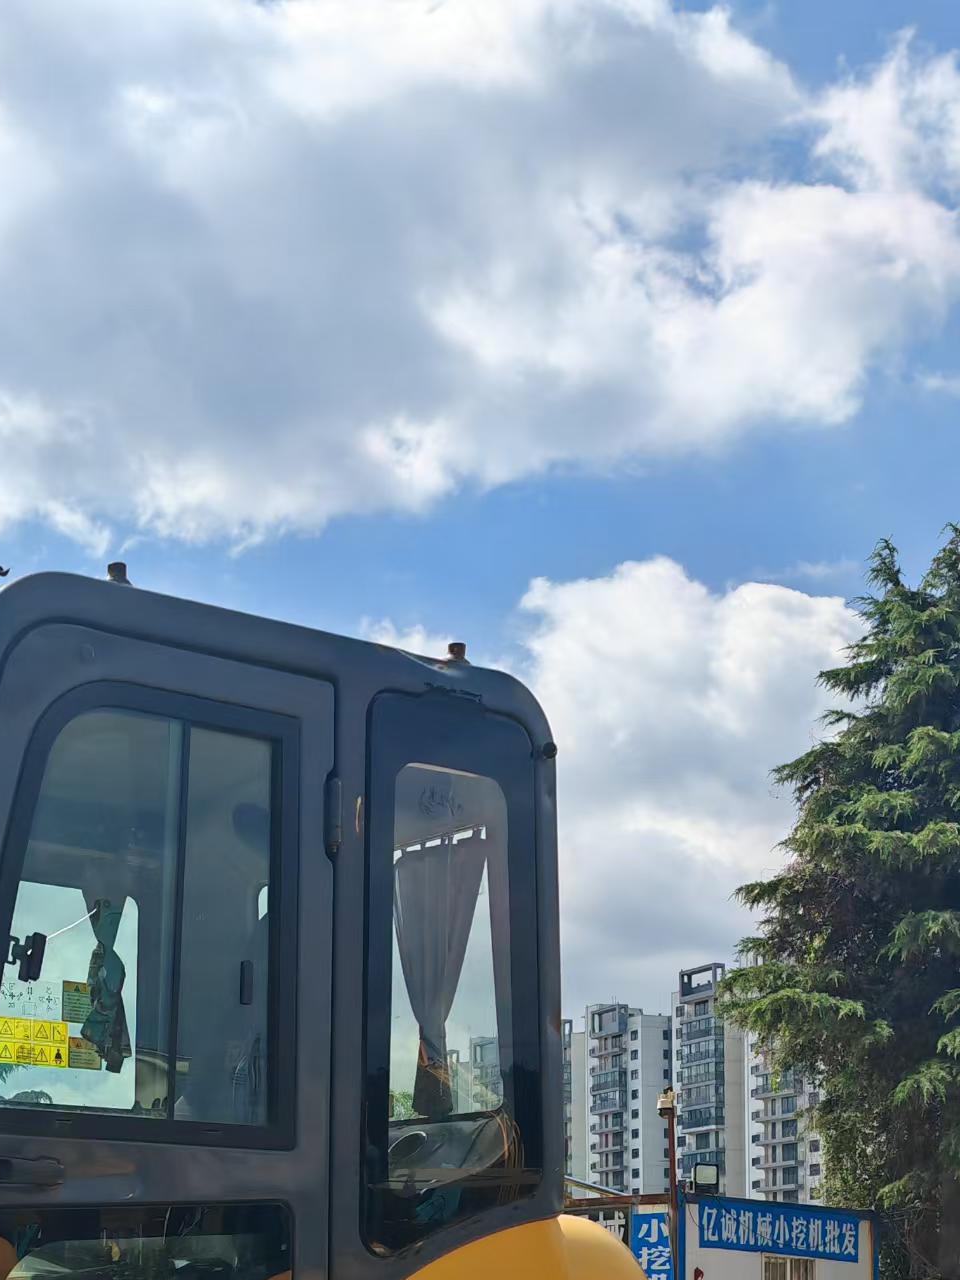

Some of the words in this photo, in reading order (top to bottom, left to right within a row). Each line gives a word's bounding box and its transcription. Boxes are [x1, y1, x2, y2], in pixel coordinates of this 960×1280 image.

[702, 1206, 856, 1256] 亿诚机械小挖机批发
